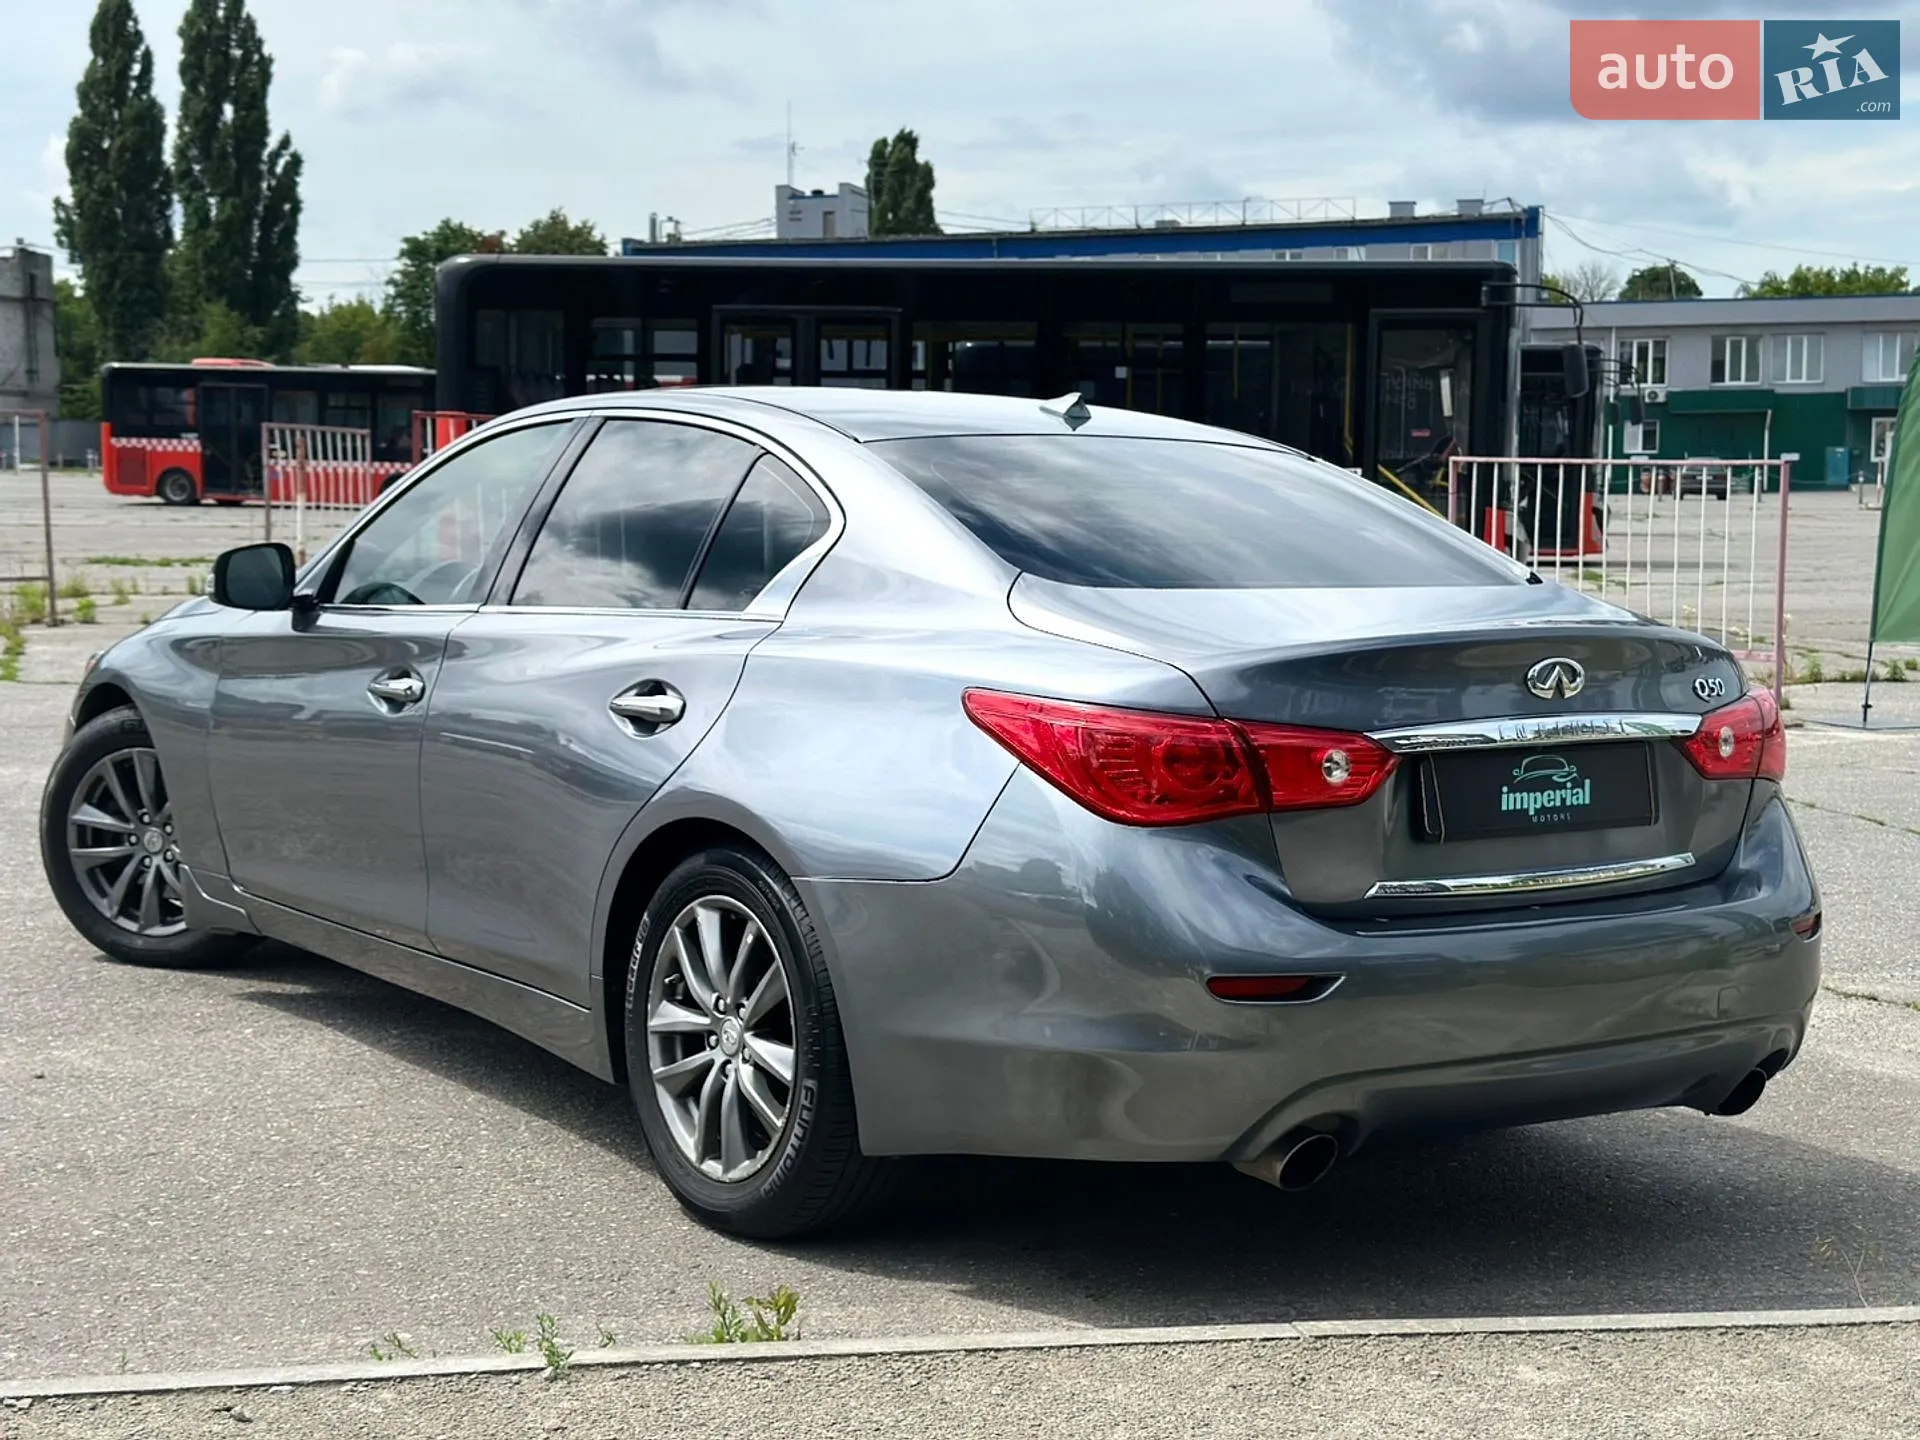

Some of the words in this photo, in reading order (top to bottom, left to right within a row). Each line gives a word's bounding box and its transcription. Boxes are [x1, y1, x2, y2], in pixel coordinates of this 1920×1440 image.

[1694, 678, 1726, 703] Q50
[1501, 779, 1591, 815] imperial
[1532, 813, 1571, 823] MOTORS
